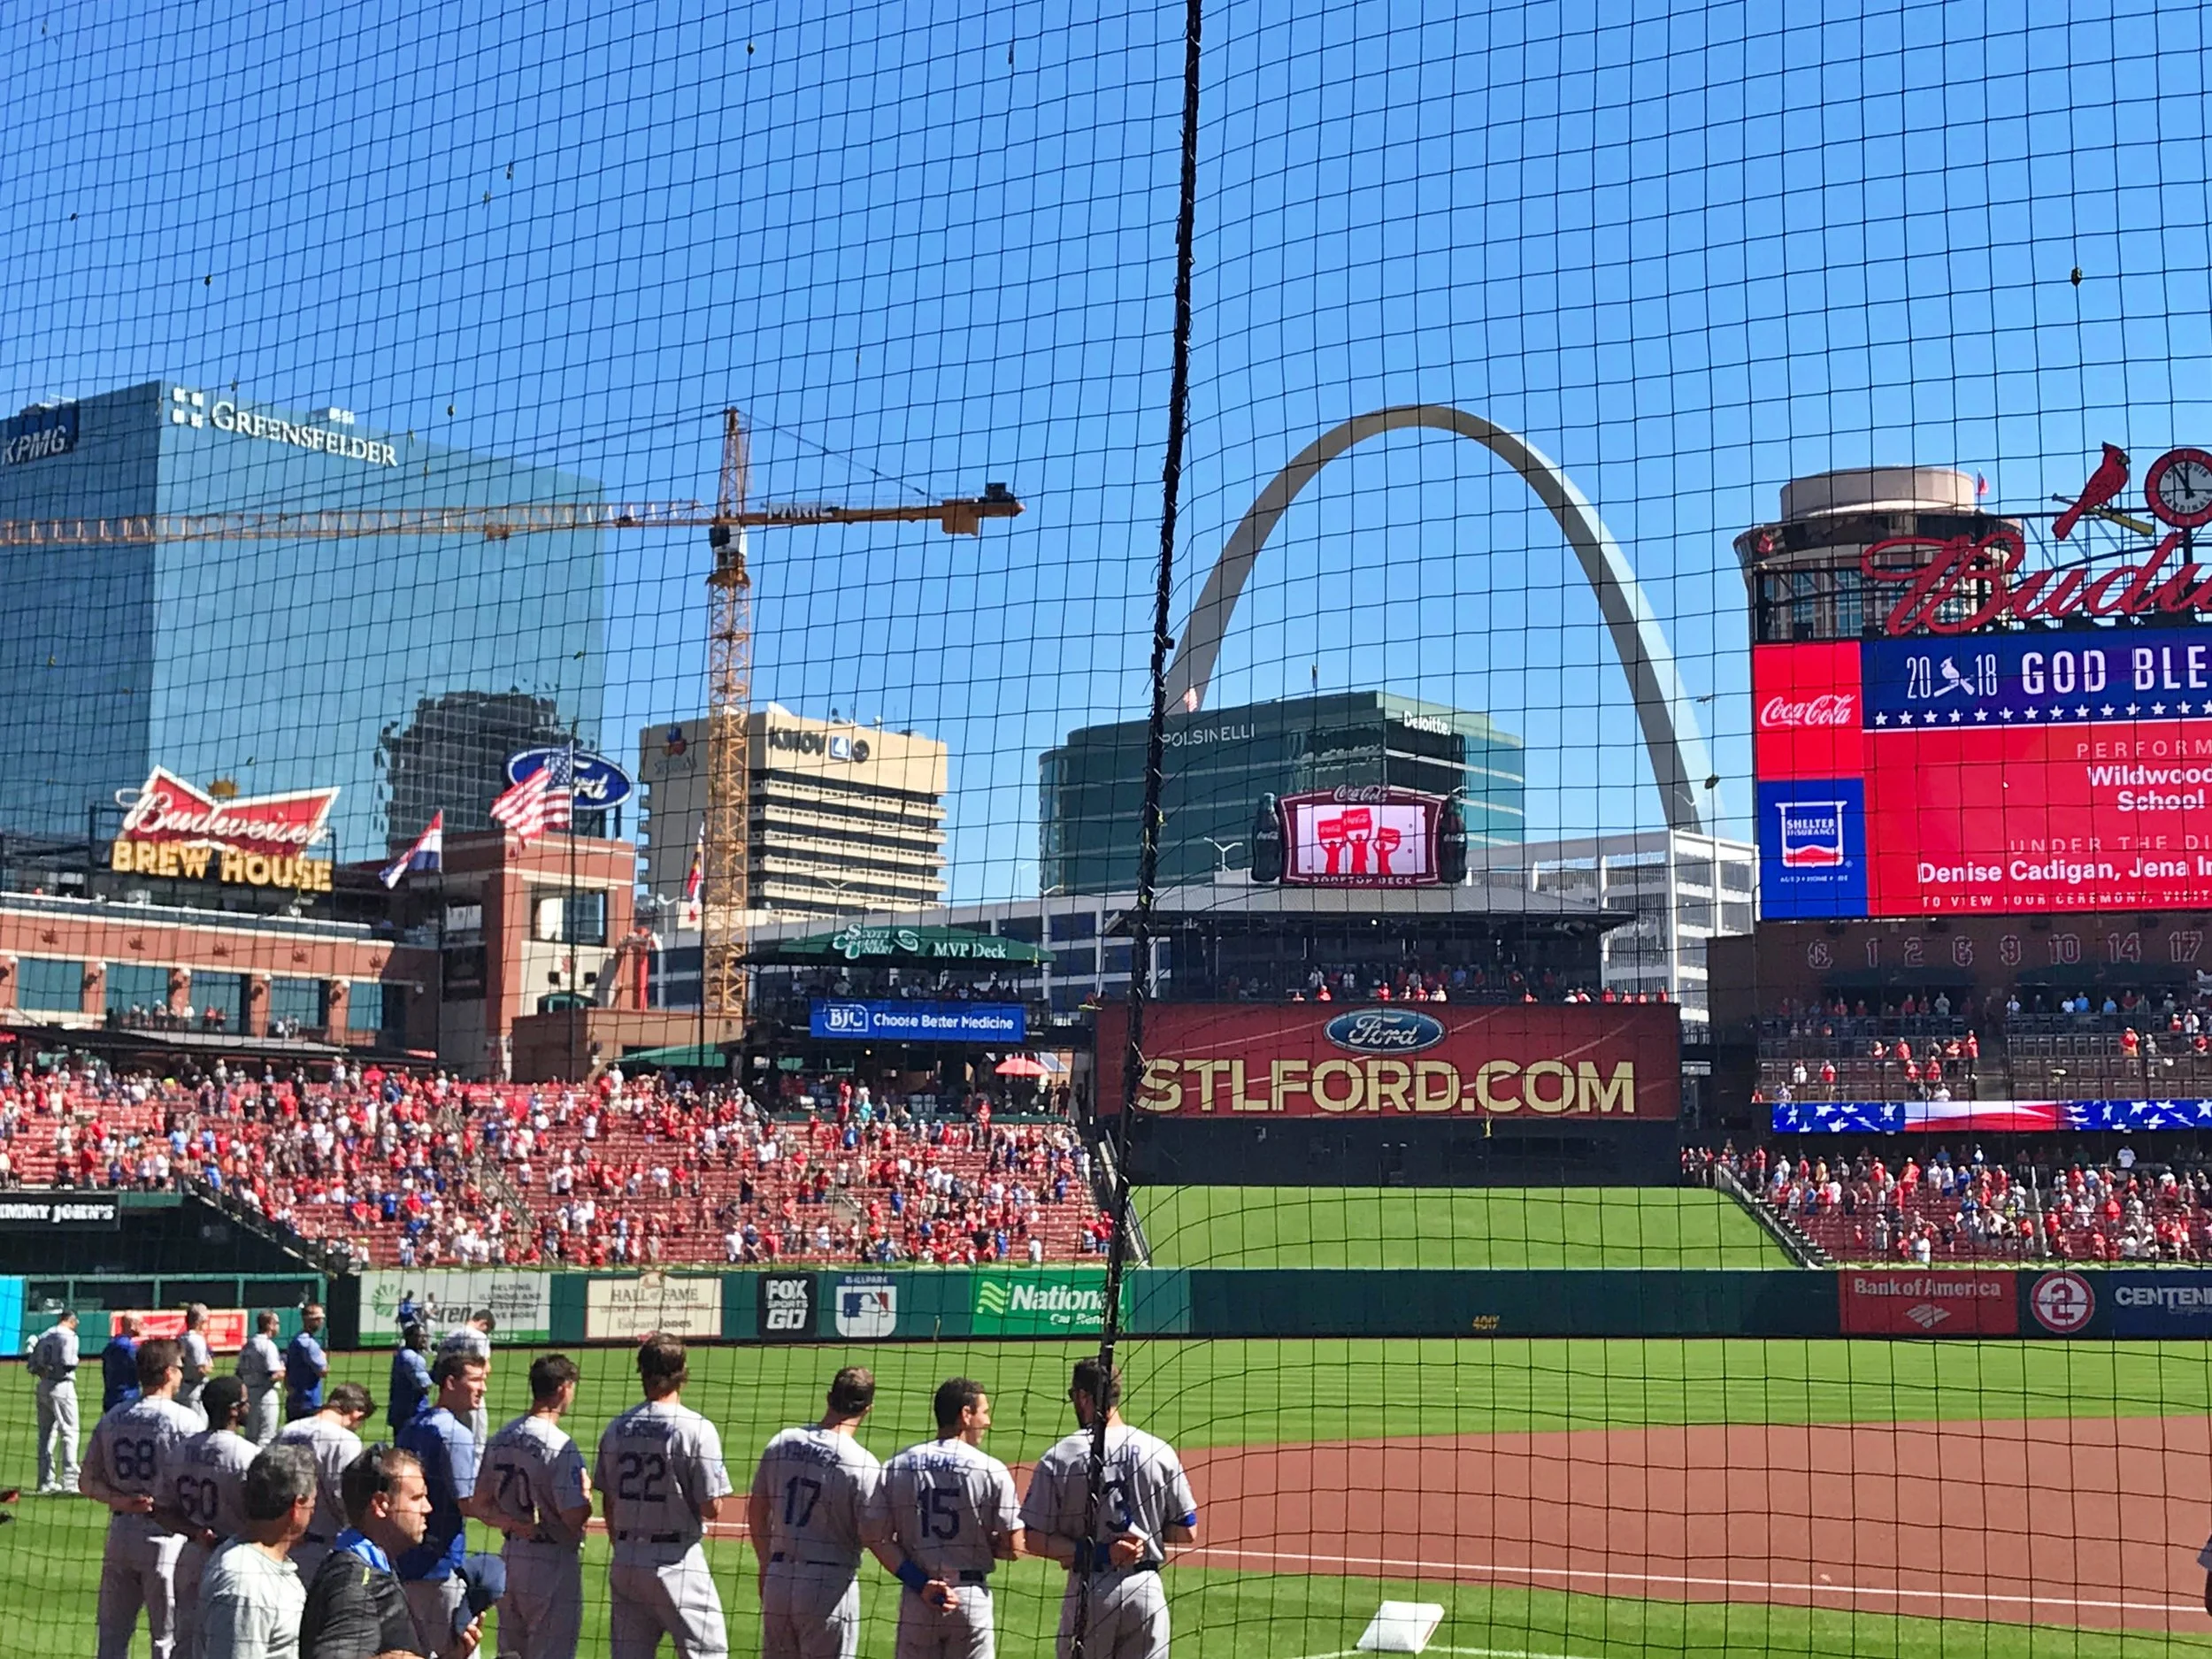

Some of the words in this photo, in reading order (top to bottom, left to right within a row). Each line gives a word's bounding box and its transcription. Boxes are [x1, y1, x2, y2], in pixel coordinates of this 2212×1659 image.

[1, 425, 67, 465] KPMG
[211, 400, 398, 468] GREENSFELDER
[2021, 650, 2106, 695] GOD
[2131, 645, 2208, 691] BLE
[1760, 694, 1855, 726] Coca-Cola
[115, 788, 330, 844] Budweiser
[2117, 789, 2205, 812] School
[1786, 818, 1835, 830] SHELTER
[2010, 838, 2101, 855] UNDER
[2118, 835, 2167, 850] THE
[112, 841, 211, 879] BREW
[223, 844, 333, 892] HOUSE
[1378, 876, 1412, 885] DECK
[1918, 862, 2002, 884] Denise
[2010, 860, 2121, 884] Cadigan,
[2129, 856, 2190, 879] Jena
[1923, 895, 1941, 908] TO
[1951, 895, 1993, 908] VIEW
[933, 941, 970, 958] MVP
[972, 942, 1006, 958] Deck
[1904, 936, 1924, 967] 2
[2000, 934, 2022, 965] 9
[2047, 933, 2080, 964] 10
[2108, 932, 2142, 964] 14
[2168, 930, 2203, 963] 17
[830, 1009, 864, 1028] BJC
[872, 1013, 918, 1027] Choose
[921, 1015, 957, 1028] Better
[962, 1017, 1013, 1030] Medicine
[1348, 1015, 1421, 1045] Ford
[1138, 1060, 1635, 1114] STLFORD.COM
[611, 1289, 649, 1302] HALL
[661, 1288, 698, 1302] FAME
[766, 1279, 808, 1300] FOX
[1855, 1278, 1901, 1295] Bank
[1903, 1278, 1921, 1295] of
[1922, 1278, 2001, 1297] America
[2051, 1283, 2074, 1319] 2
[766, 1310, 807, 1329] GO
[113, 1437, 157, 1481] 68
[494, 1463, 535, 1513] 70
[619, 1451, 664, 1502] 22
[177, 1474, 219, 1522] 60
[785, 1475, 821, 1528] 17
[918, 1487, 961, 1540] 15
